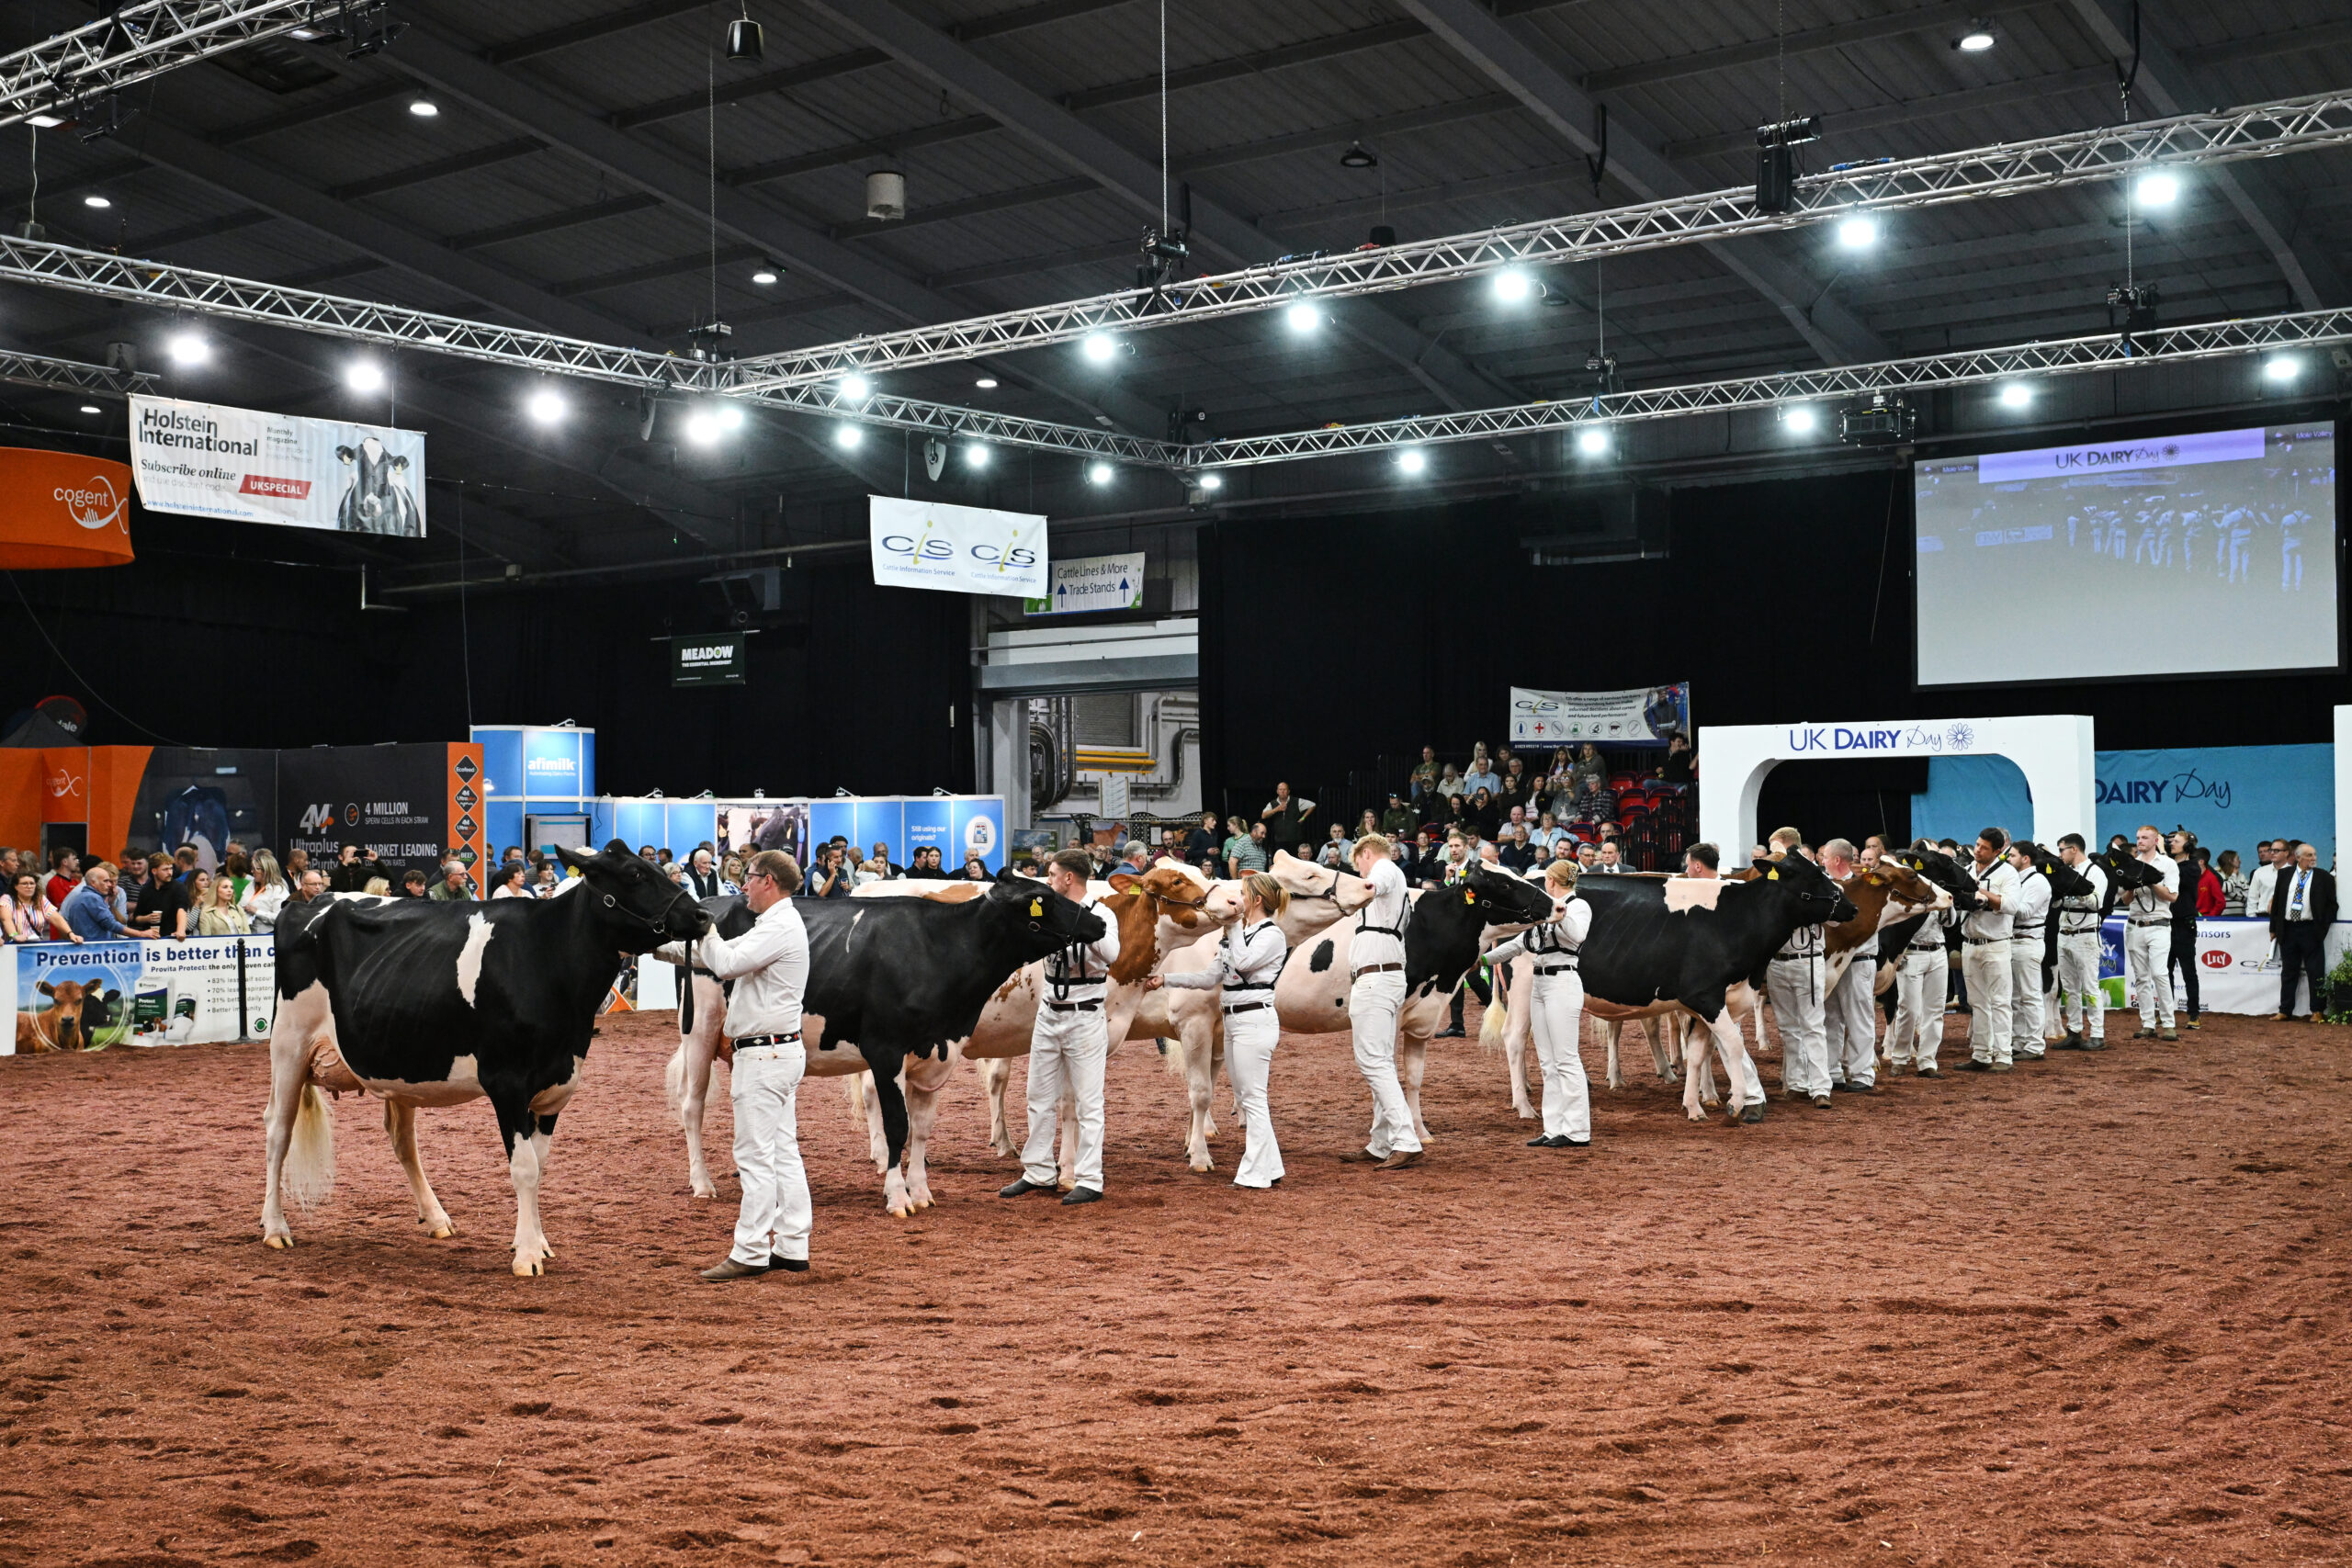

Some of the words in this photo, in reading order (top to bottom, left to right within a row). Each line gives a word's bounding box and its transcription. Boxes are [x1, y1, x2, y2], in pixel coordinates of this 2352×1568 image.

[143, 408, 218, 438] Holstein
[139, 421, 258, 457] International
[2055, 453, 2083, 469] UK
[2087, 449, 2133, 467] DAIRY
[141, 458, 197, 477] Subscribe
[198, 467, 236, 480] online
[250, 479, 302, 495] UKSPECIAL
[53, 487, 108, 507] cogent
[883, 563, 899, 571] Cattle
[899, 566, 933, 575] Information
[933, 568, 956, 577] Service
[987, 573, 1019, 582] Information
[1057, 567, 1079, 579] Cattle
[1080, 565, 1099, 577] Lines
[1101, 564, 1107, 575] &
[1108, 563, 1128, 574] More
[1069, 583, 1089, 596] Trade
[1090, 581, 1115, 594] Stands
[681, 646, 734, 660] MEADOW
[1790, 728, 1827, 751] UK
[1834, 728, 1902, 750] DAIRY
[1905, 725, 1942, 752] Day
[528, 757, 576, 771] afimilk
[2095, 778, 2169, 805] DAIRY
[2173, 768, 2231, 809] Day
[365, 802, 371, 816] 4
[373, 802, 409, 816] MILLION
[365, 817, 380, 825] SPERM
[381, 817, 395, 825] CELLS
[413, 816, 429, 824] STRAW
[290, 838, 339, 856] Ultraplus
[365, 844, 399, 857] MARKET
[401, 843, 438, 857] LEADING
[2196, 931, 2231, 939] onsors
[37, 949, 140, 967] Prevention
[146, 948, 161, 962] is
[166, 946, 220, 962] better
[225, 944, 262, 959] than
[178, 964, 208, 973] Protect:
[221, 964, 236, 972] only
